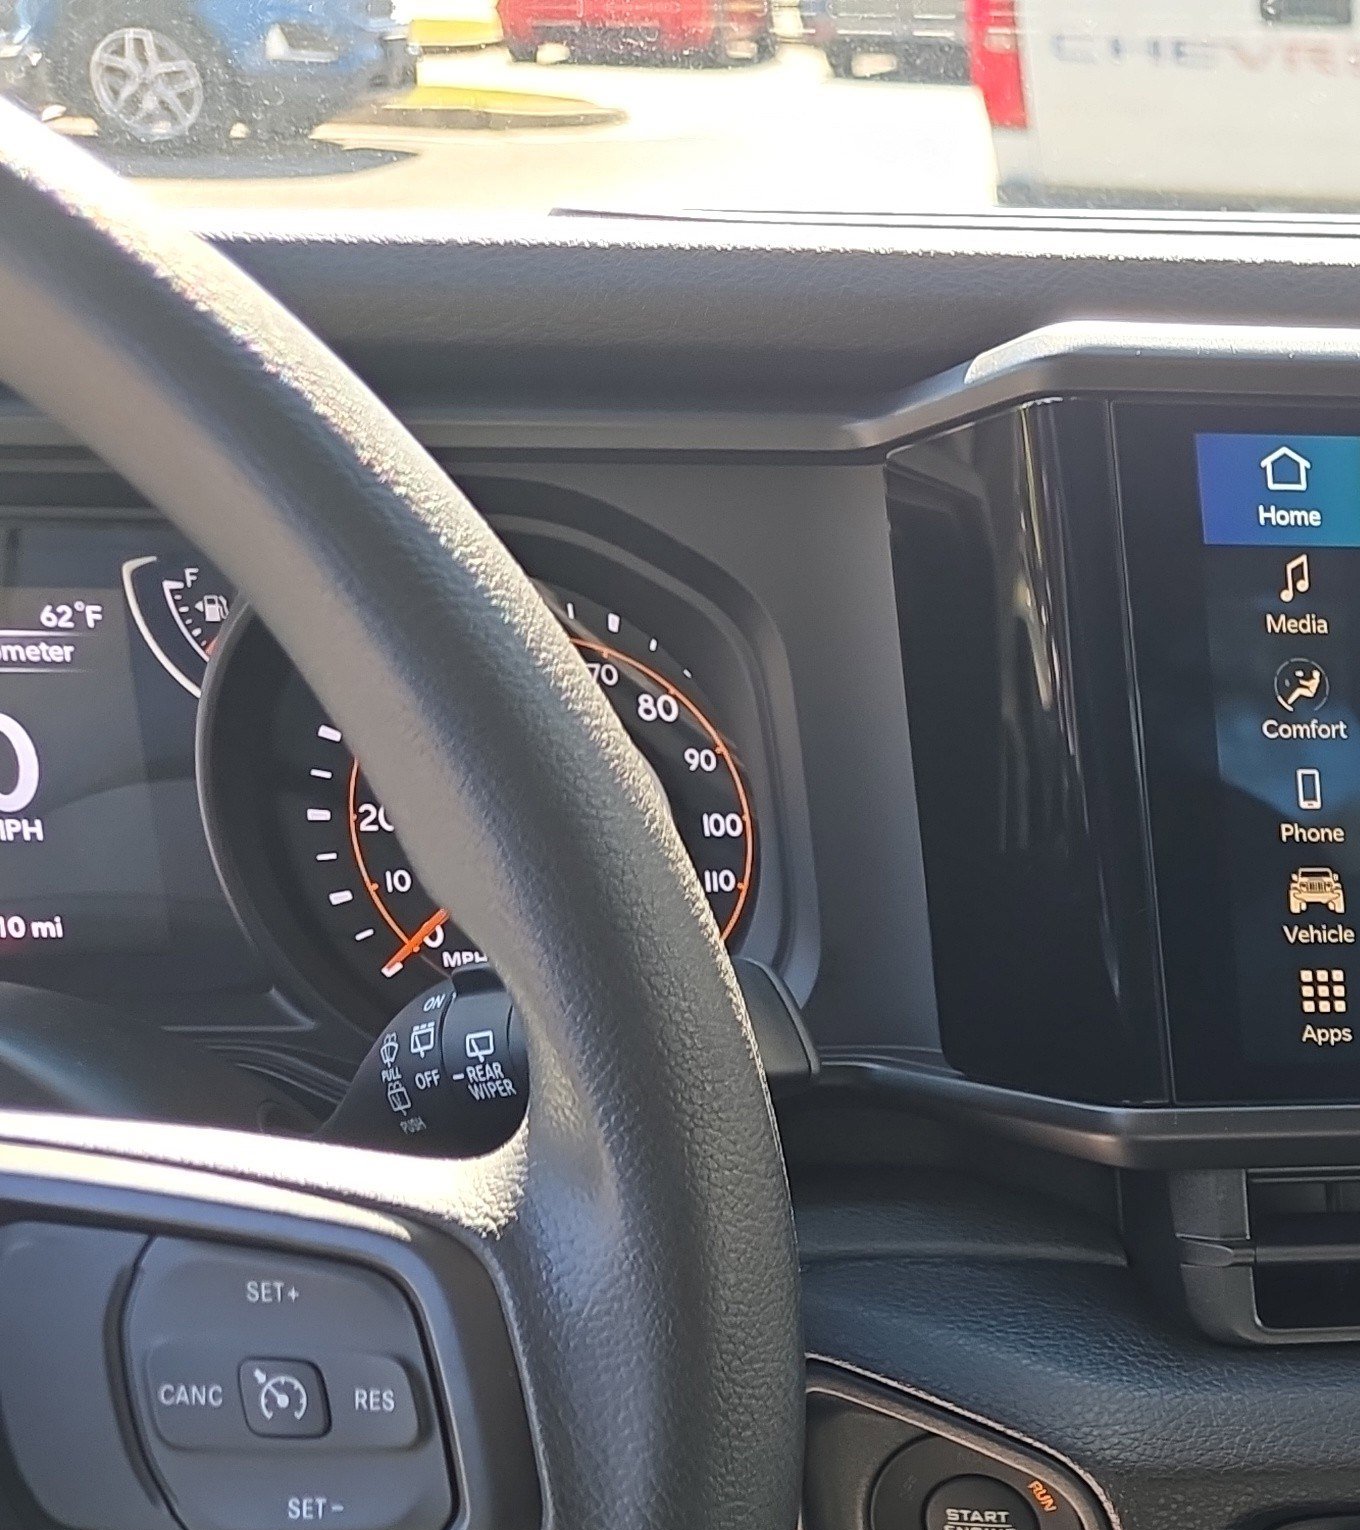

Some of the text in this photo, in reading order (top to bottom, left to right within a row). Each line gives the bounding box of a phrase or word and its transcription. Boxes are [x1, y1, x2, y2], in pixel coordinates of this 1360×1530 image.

[1258, 504, 1322, 527] Home
[184, 567, 199, 588] F
[40, 601, 103, 629] 62°F
[1265, 614, 1329, 635] Media
[0, 642, 75, 663] meter
[587, 662, 620, 687] 70
[637, 693, 680, 723] 80
[1261, 719, 1348, 741] Comfort
[683, 747, 718, 773] 90
[702, 812, 744, 838] 100
[1279, 822, 1346, 844] Phone
[385, 869, 412, 893] 10
[704, 868, 737, 893] 110
[31, 914, 64, 939] mi
[1282, 924, 1356, 944] Vehicle
[422, 993, 447, 1013] ON
[1301, 1024, 1354, 1047] Apps
[381, 1068, 403, 1083] PULL
[414, 1069, 442, 1090] OFF
[465, 1061, 506, 1083] REAR
[468, 1078, 518, 1101] WIPER
[159, 1383, 223, 1407] CANC
[354, 1389, 396, 1412] RES
[1027, 1480, 1058, 1513] RUN
[945, 1507, 1011, 1524] START
